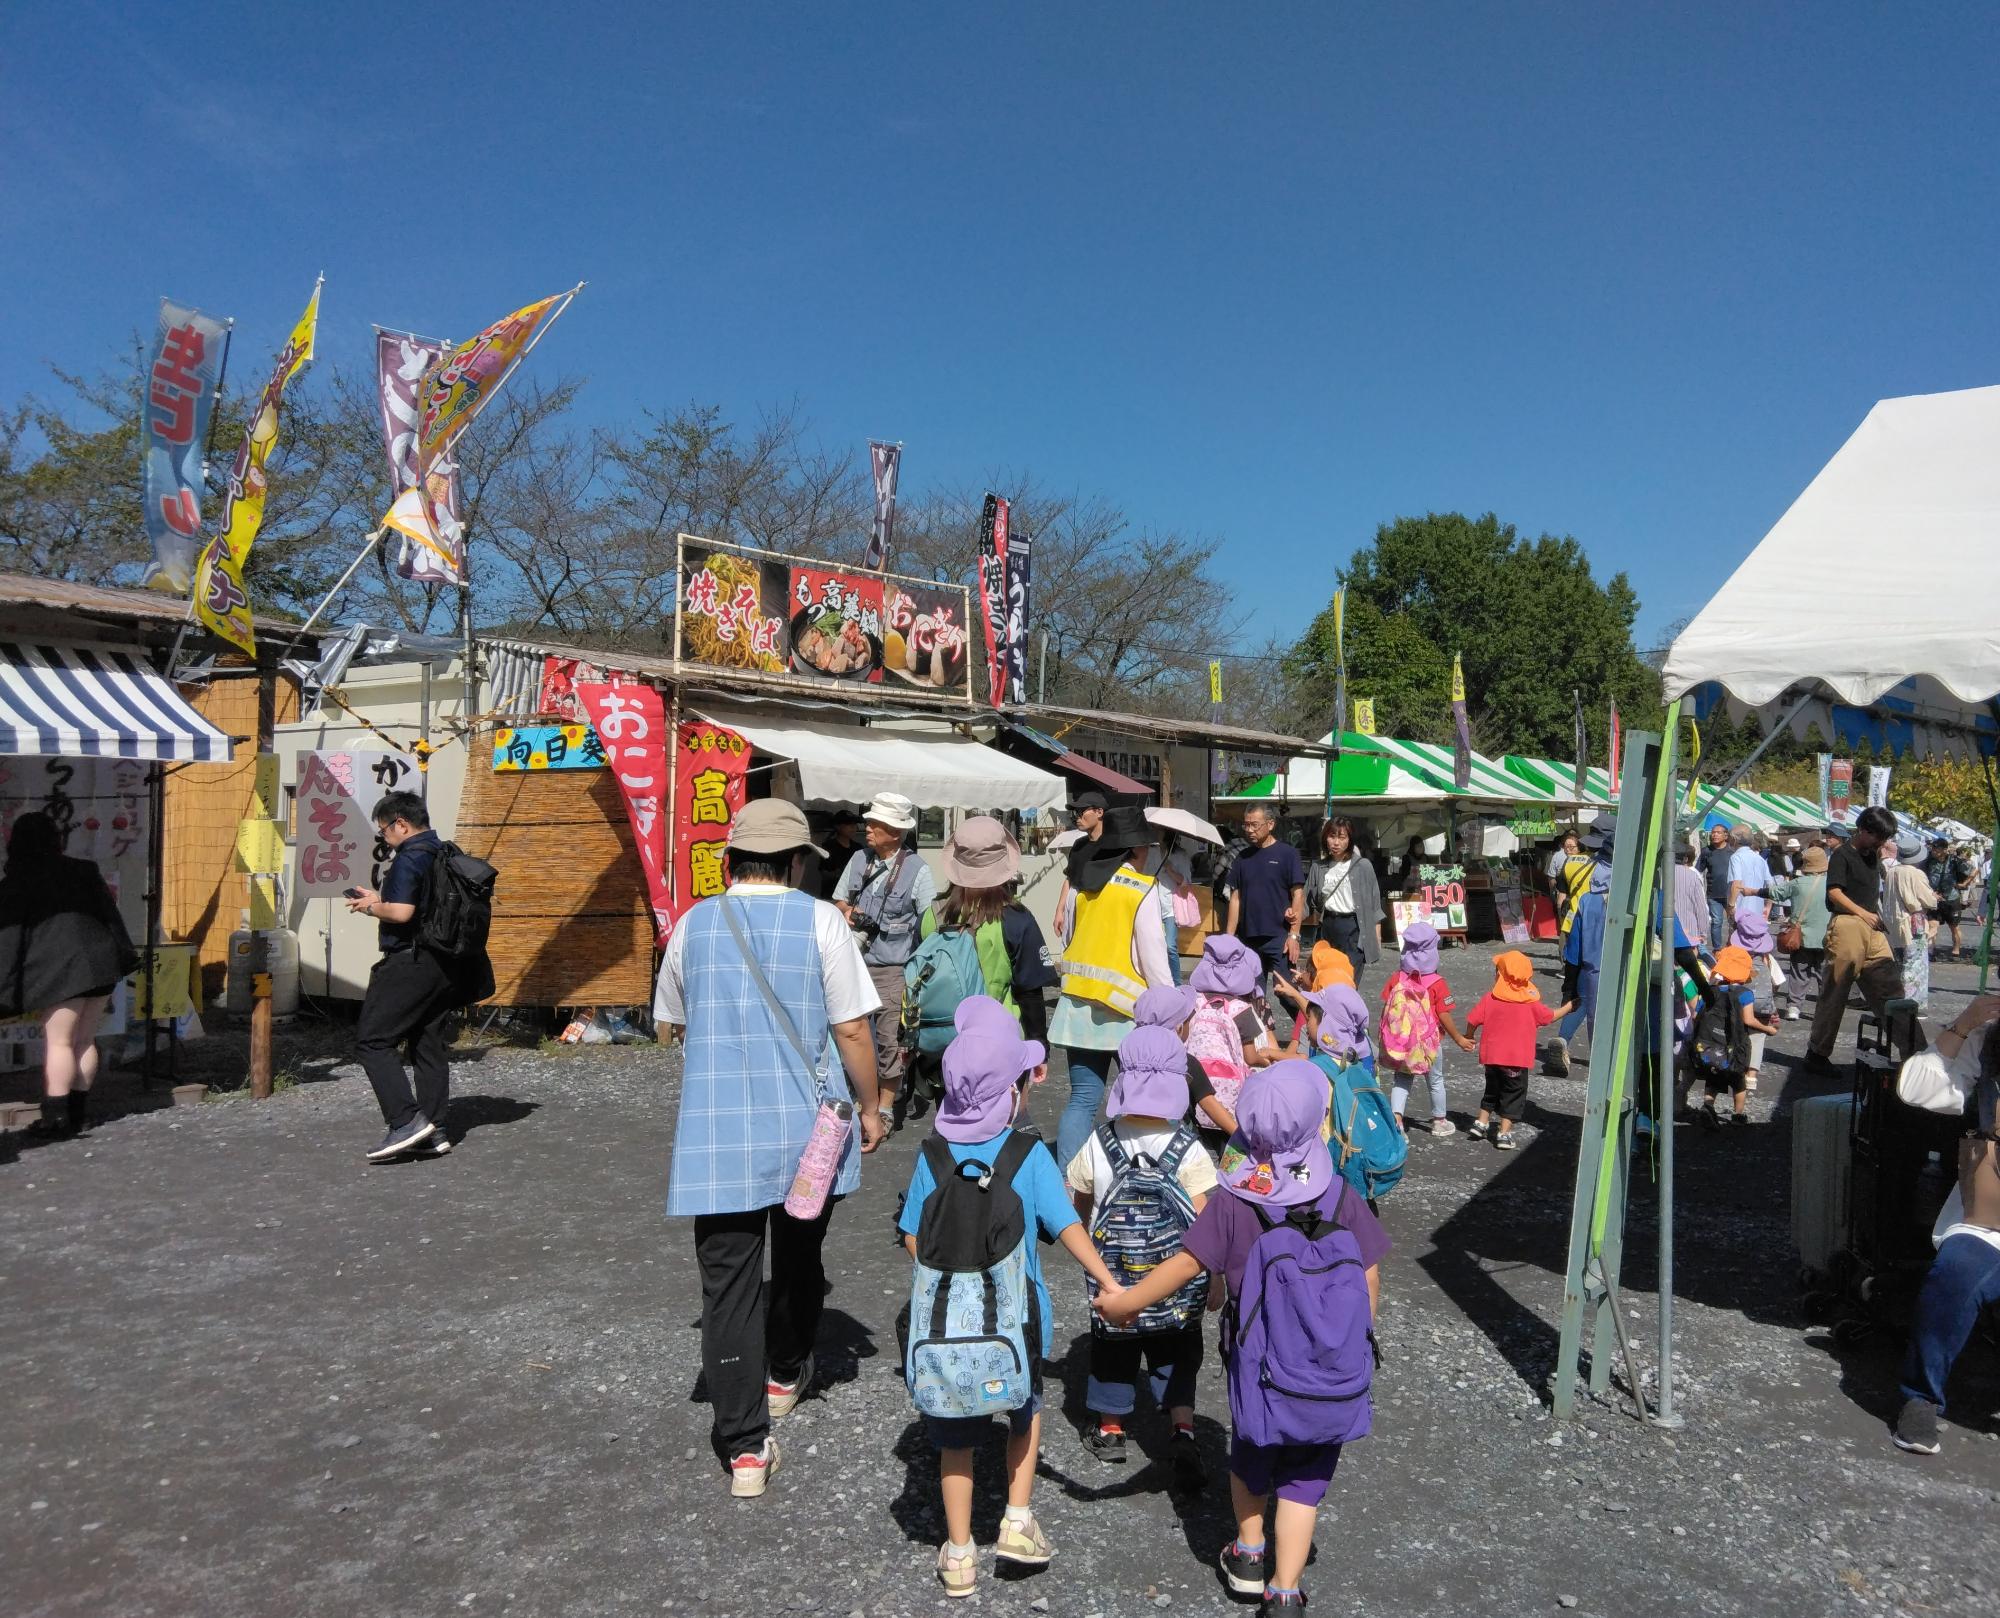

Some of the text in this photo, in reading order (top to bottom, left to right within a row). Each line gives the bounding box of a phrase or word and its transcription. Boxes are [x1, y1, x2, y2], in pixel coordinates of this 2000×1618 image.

[687, 567, 783, 656] 焼きそば
[889, 591, 964, 663] おにぎり
[687, 733, 746, 759] 地元名物
[298, 752, 358, 884] 焼そば
[690, 768, 730, 898] 高麗
[1421, 882, 1464, 908] 150
